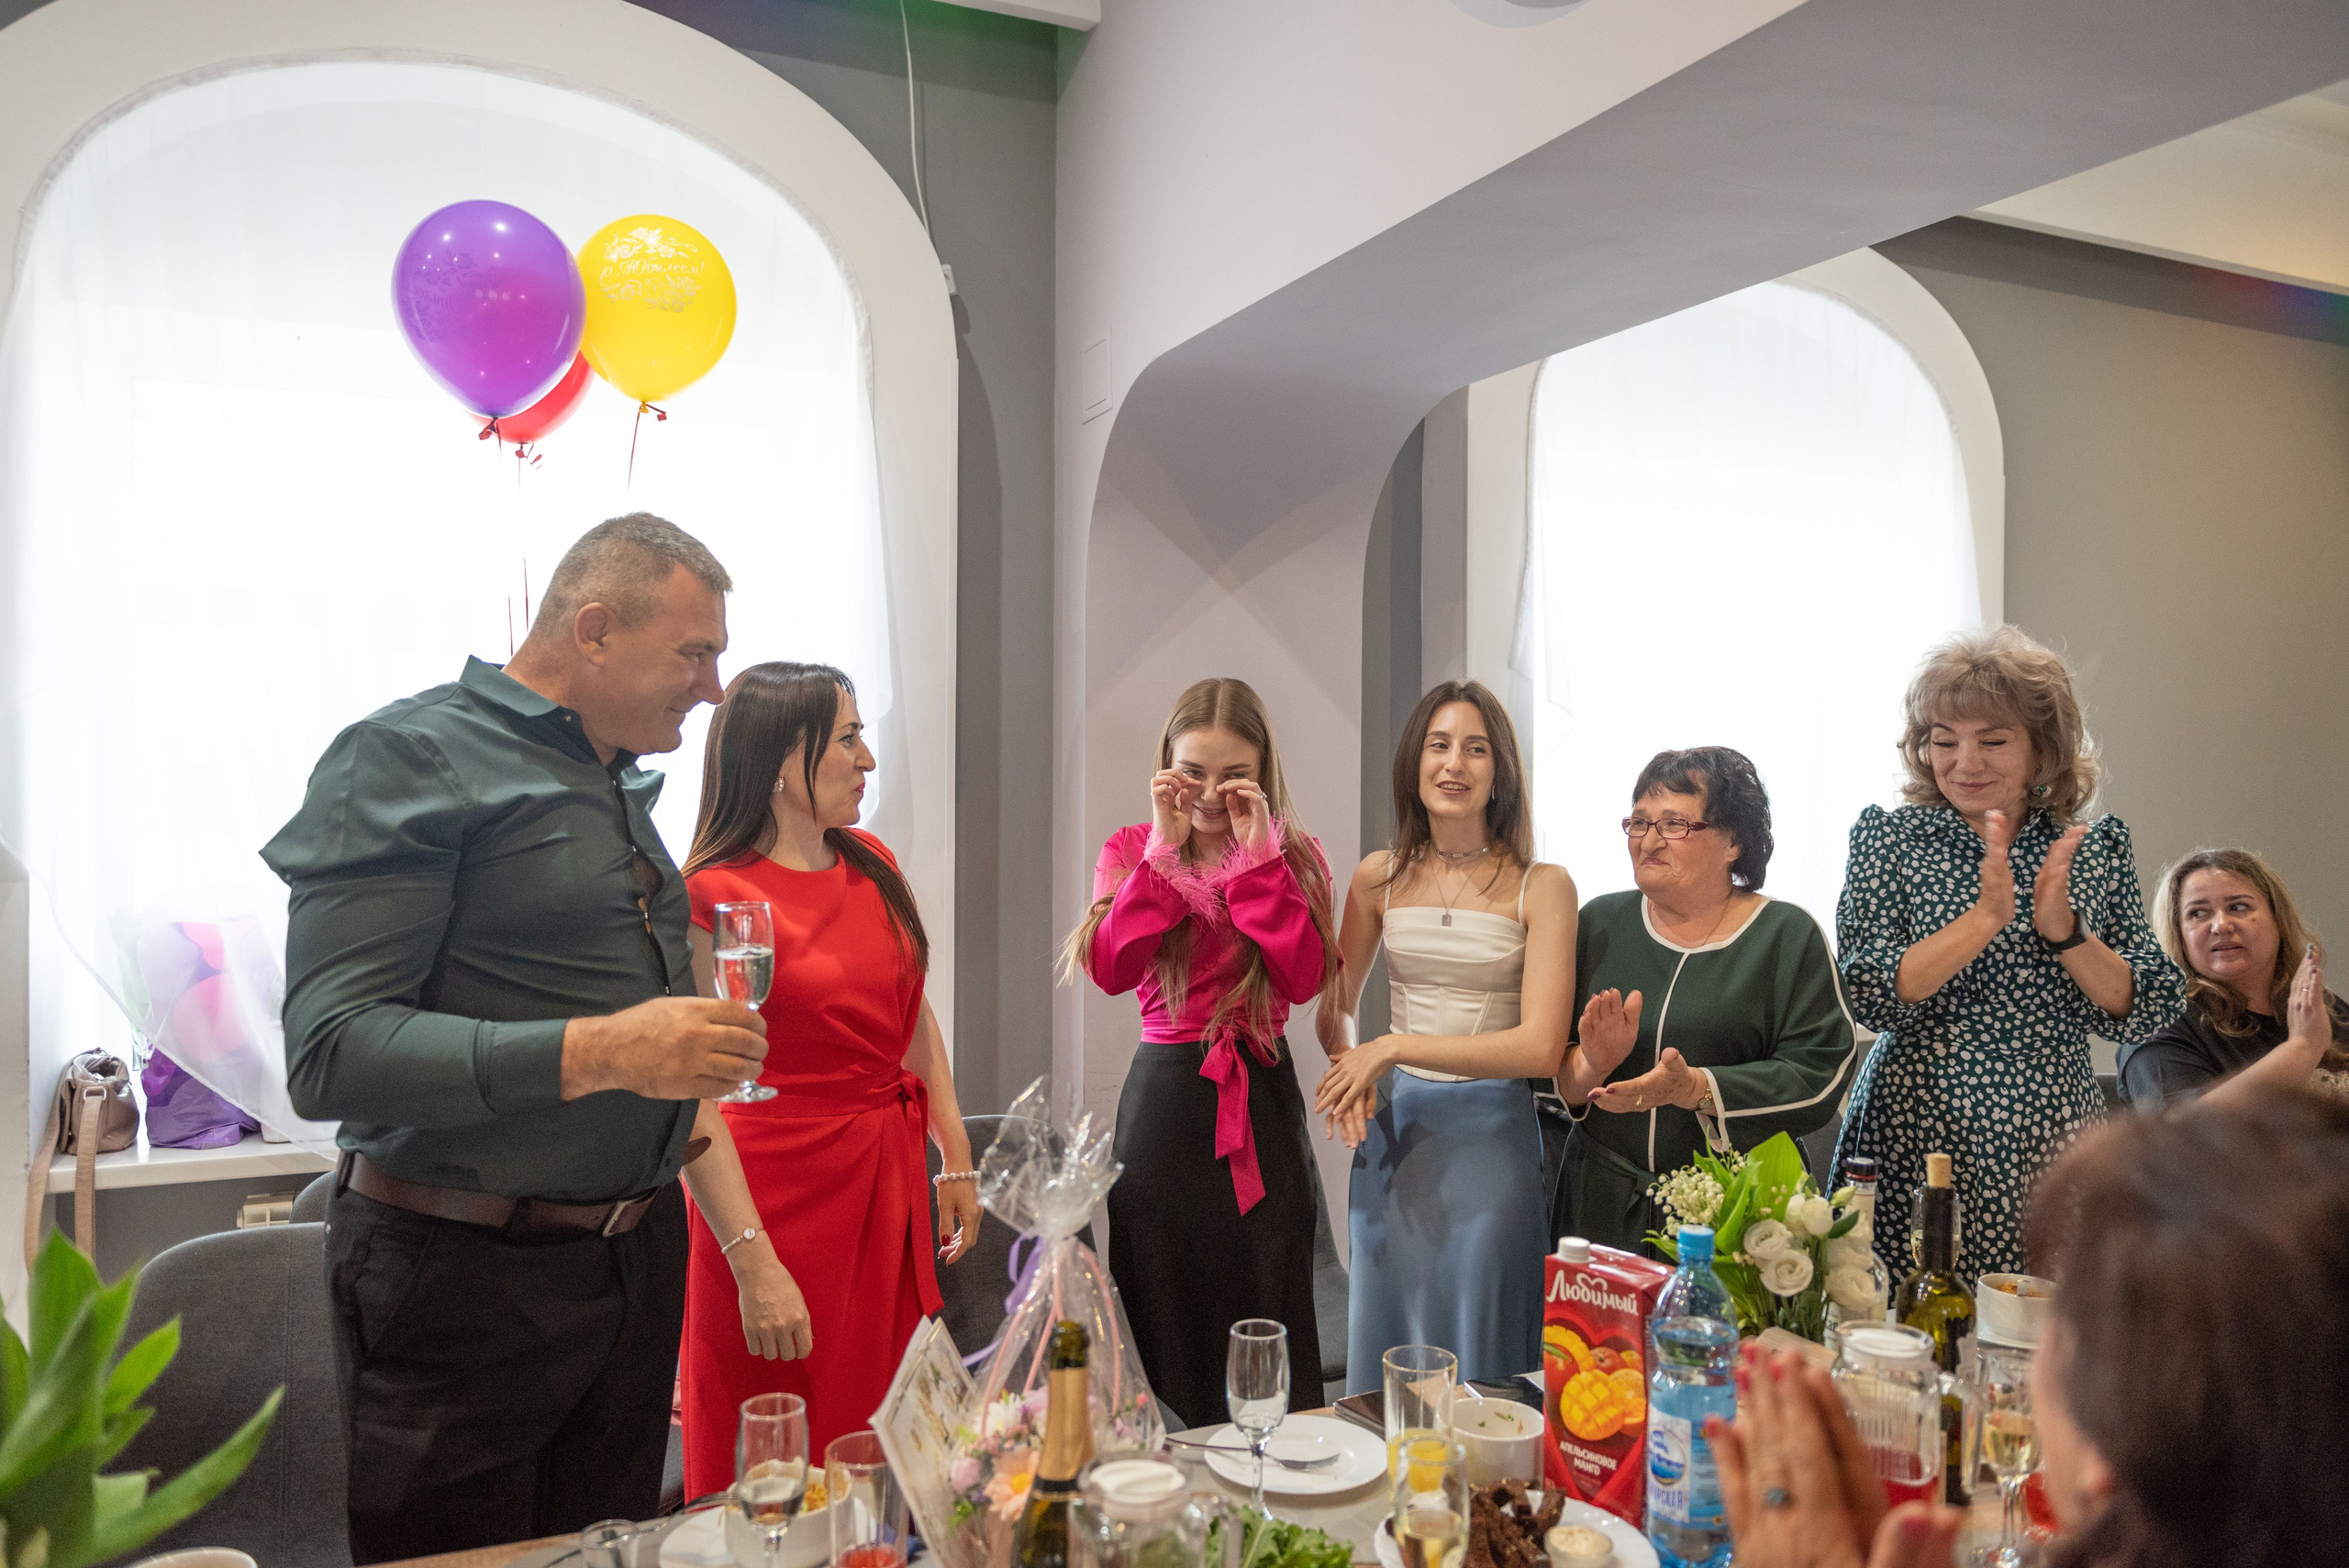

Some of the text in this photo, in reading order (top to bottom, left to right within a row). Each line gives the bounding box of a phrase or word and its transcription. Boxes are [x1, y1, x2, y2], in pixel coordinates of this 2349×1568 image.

[1546, 1269, 1639, 1316] Любимый
[1560, 1440, 1617, 1470] АПЕЛЬСИНОВОЕ
[1573, 1456, 1600, 1475] МАНГО
